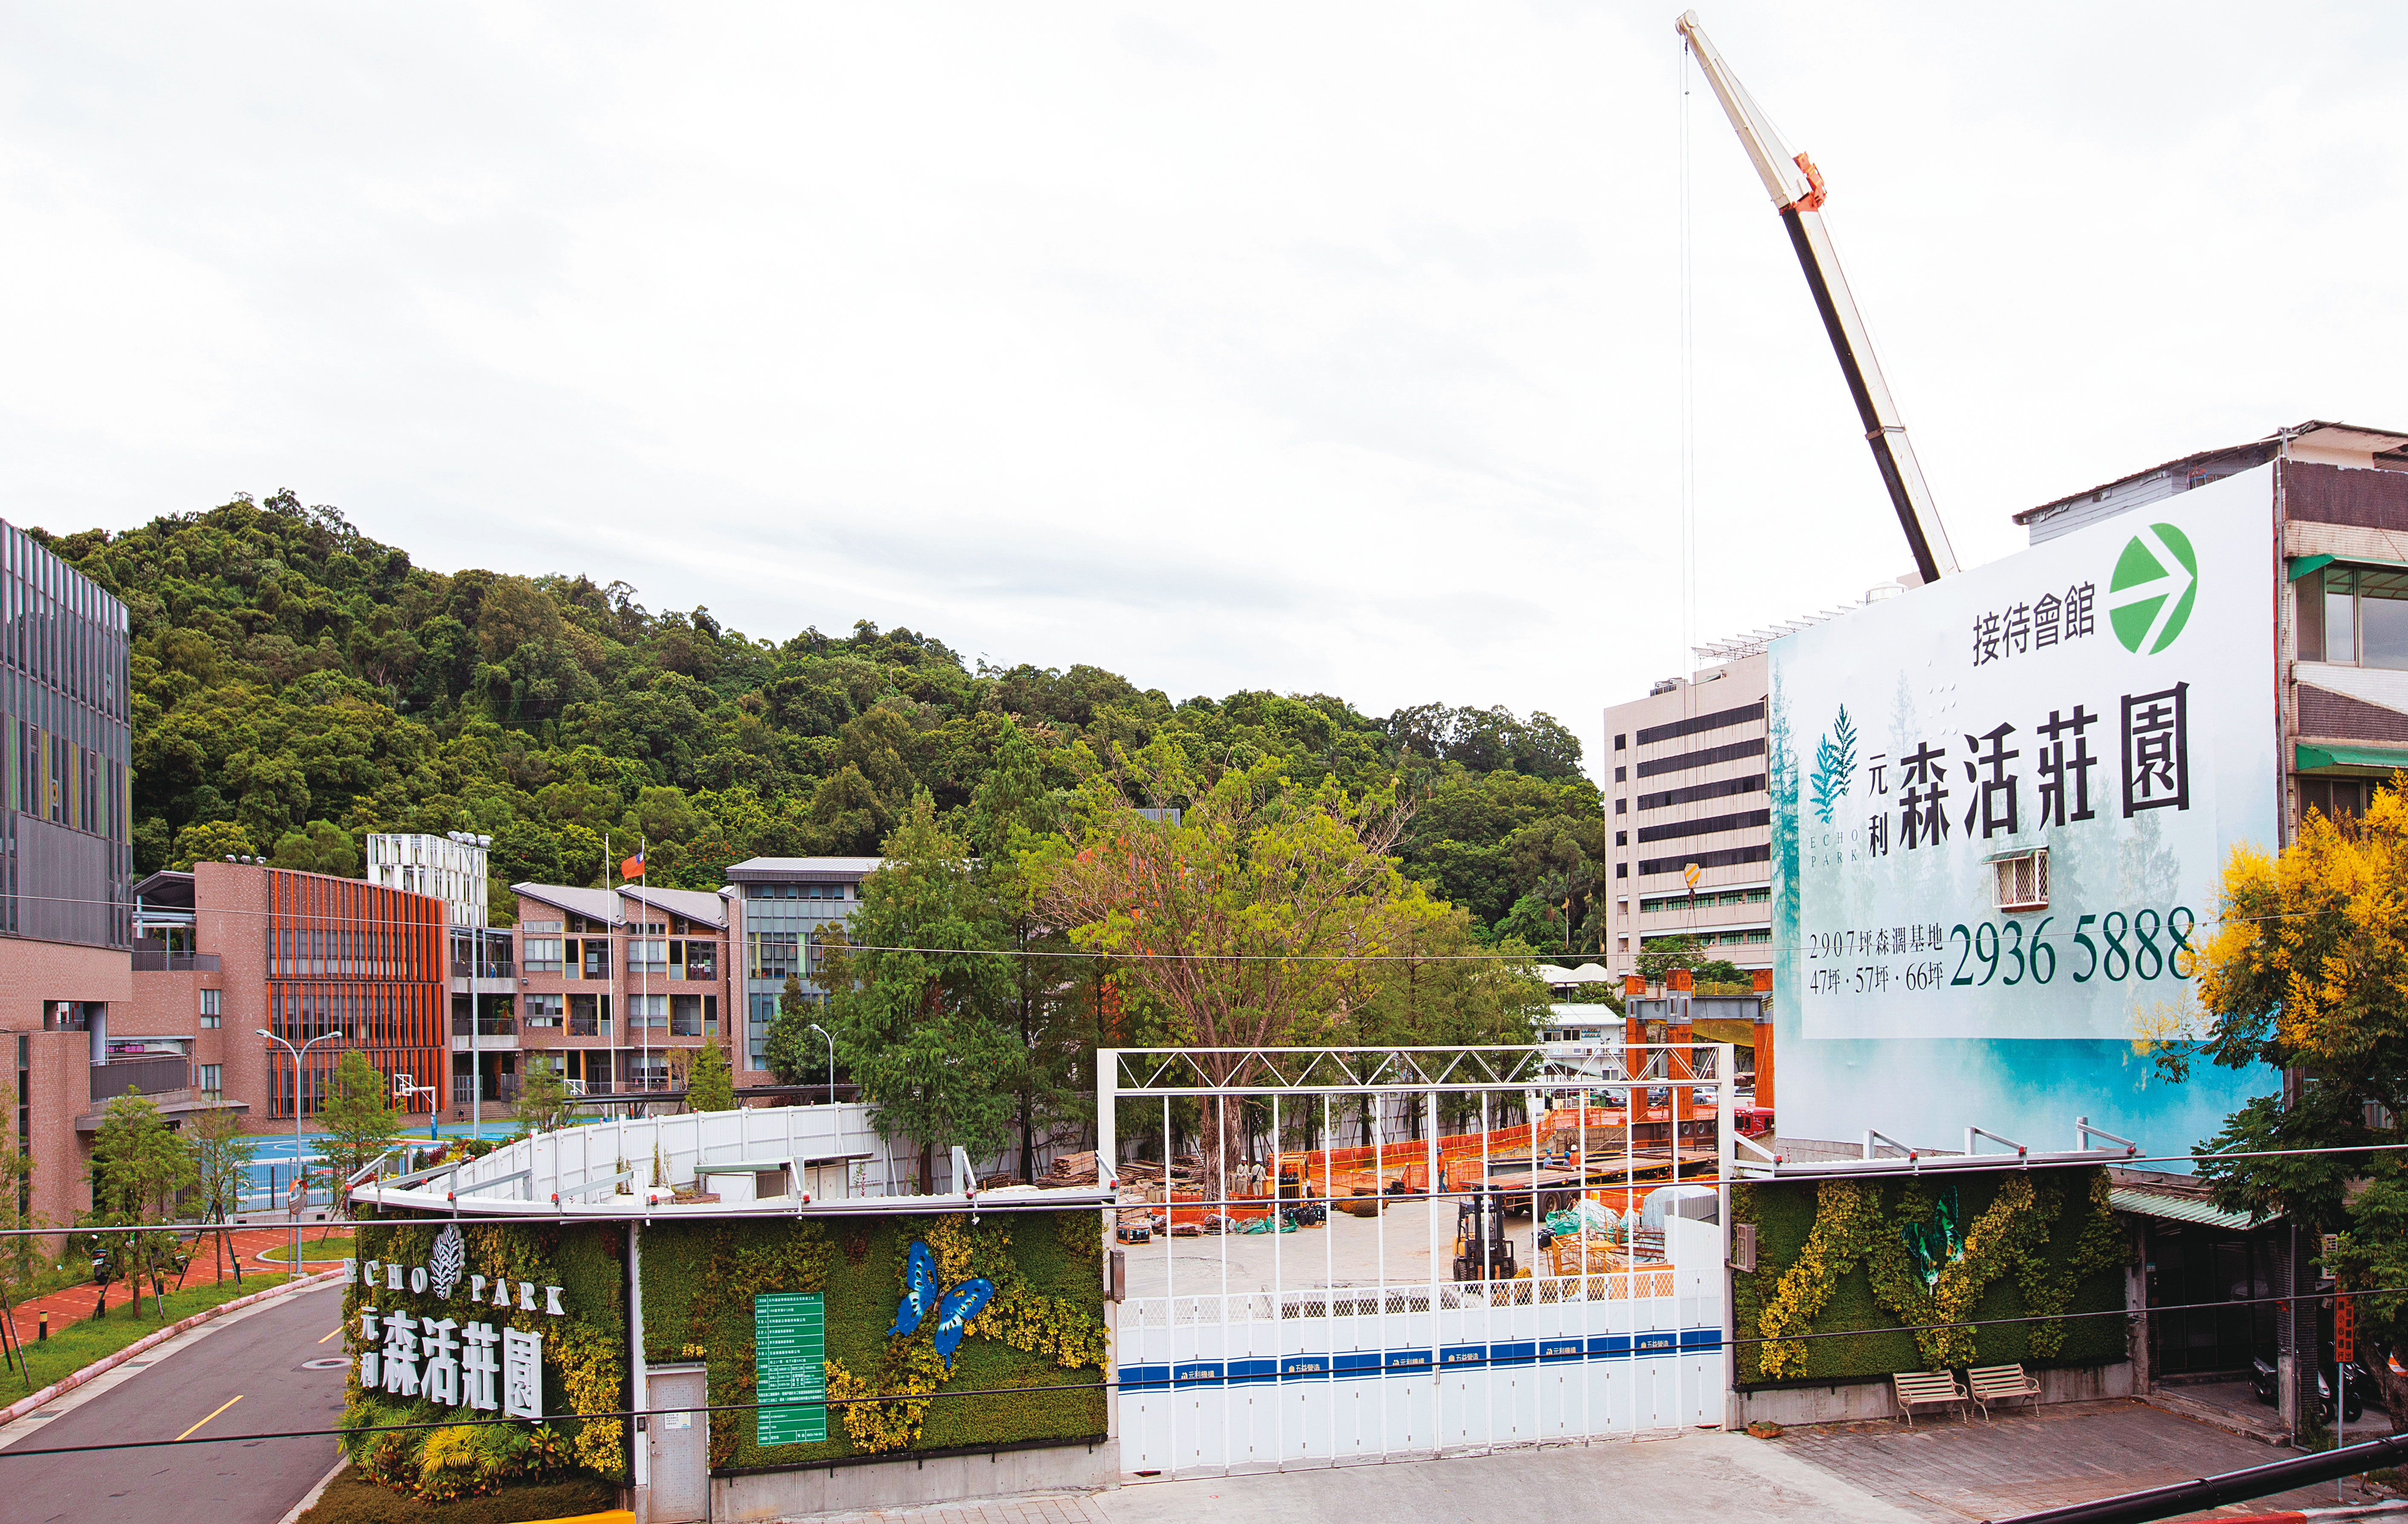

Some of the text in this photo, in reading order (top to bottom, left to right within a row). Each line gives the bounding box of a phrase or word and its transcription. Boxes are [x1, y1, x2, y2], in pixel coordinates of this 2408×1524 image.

[1973, 581, 2096, 667] 接待會館
[1868, 753, 1888, 858] 元利
[1899, 681, 2190, 850] 森活莊園
[1810, 829, 1858, 848] ECHO
[1811, 849, 1857, 867] PARK
[1950, 906, 2196, 986] 2936 5888
[343, 1257, 565, 1315] ECHO PARK
[360, 1306, 379, 1389] 元利
[383, 1310, 543, 1425] 森活莊園
